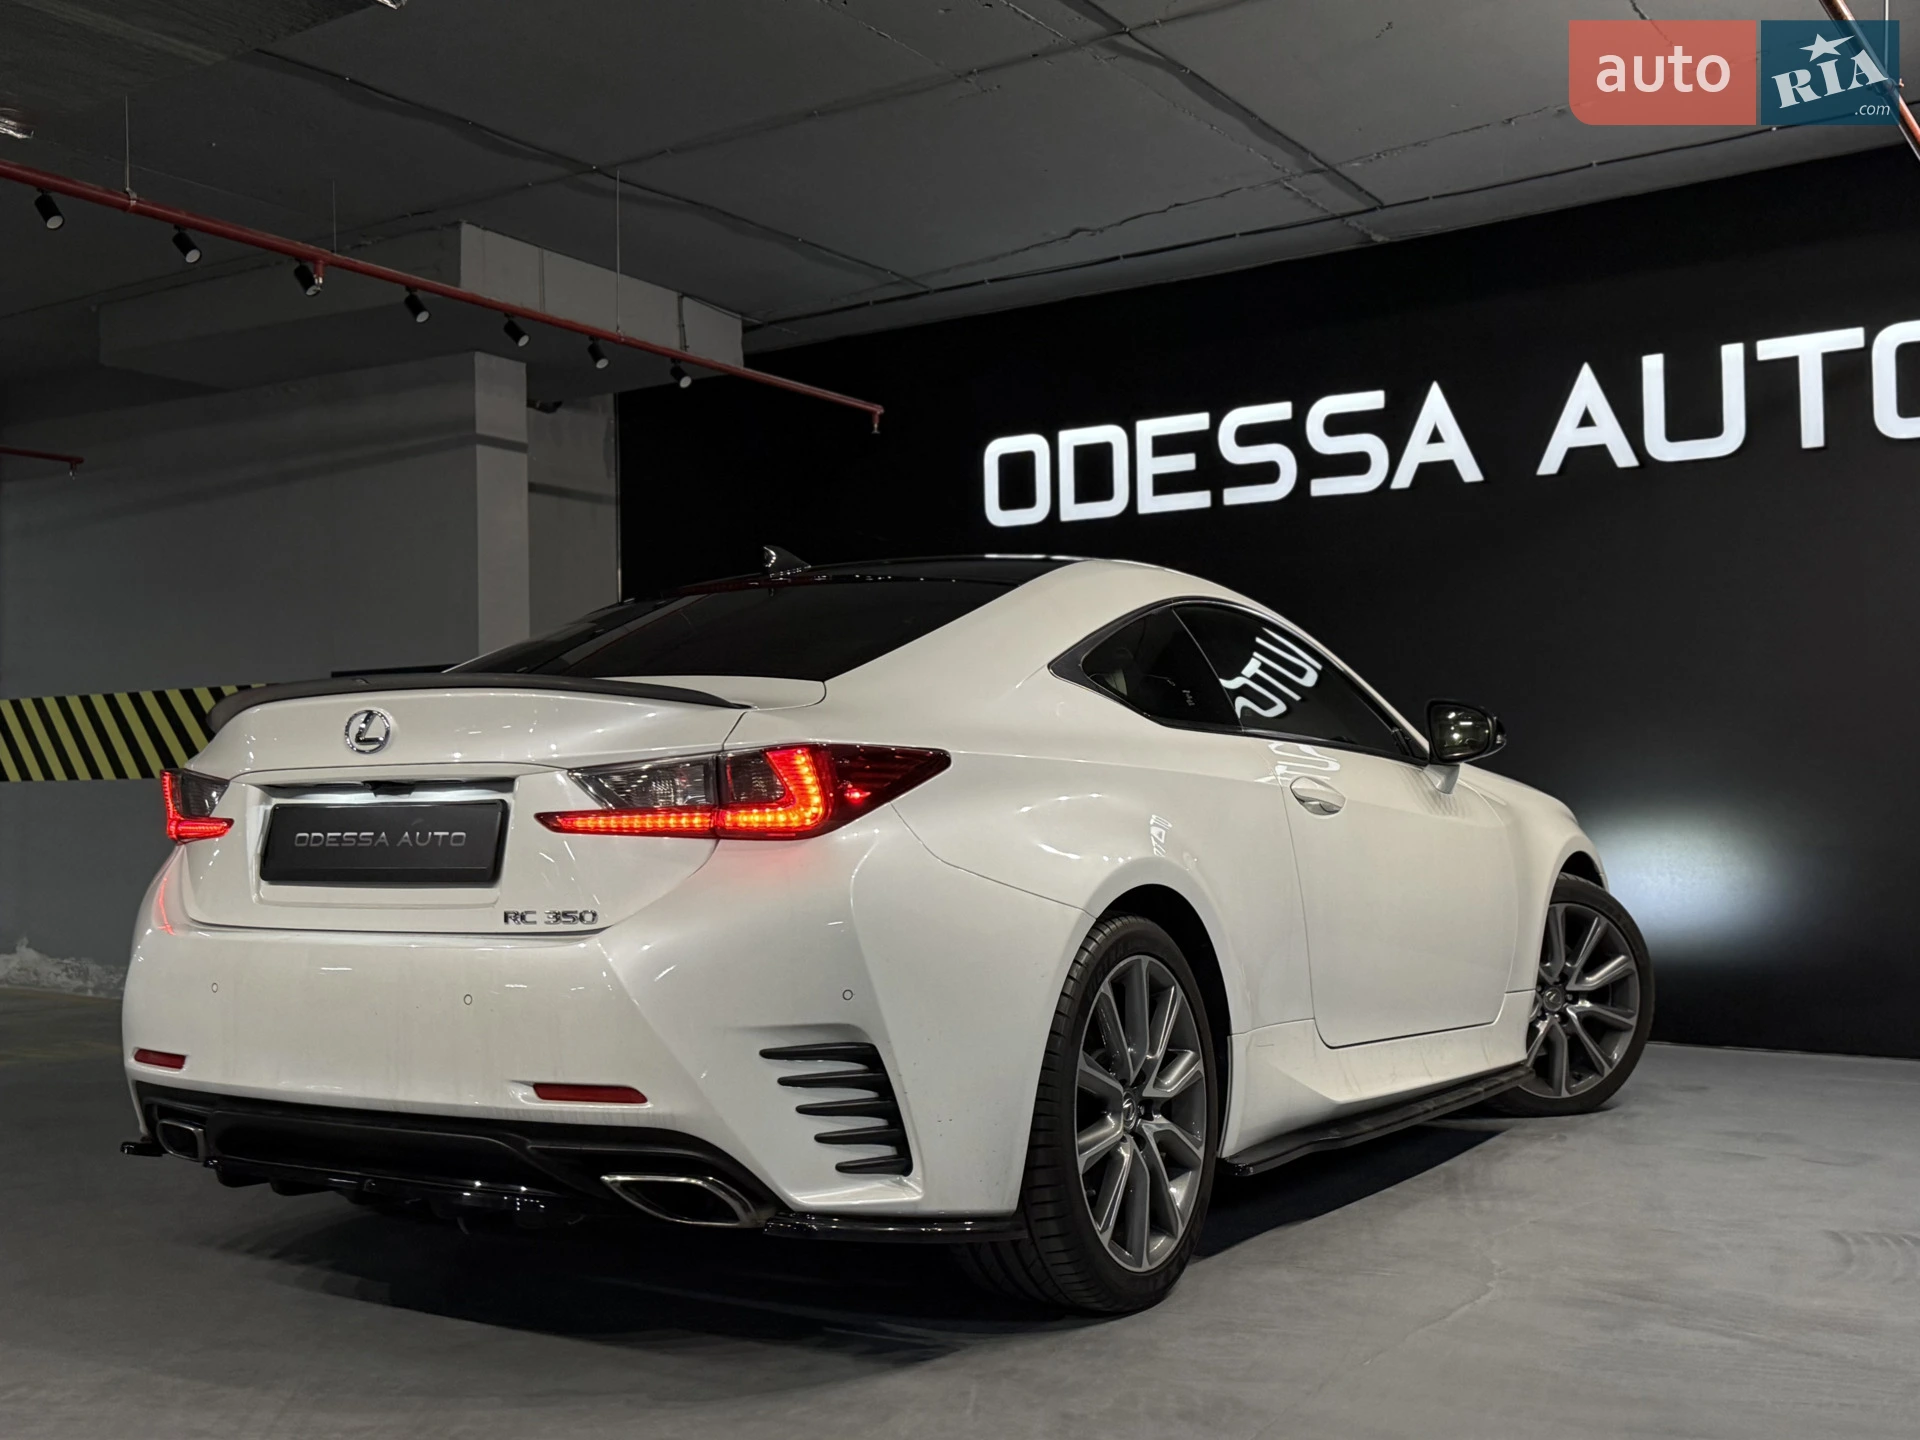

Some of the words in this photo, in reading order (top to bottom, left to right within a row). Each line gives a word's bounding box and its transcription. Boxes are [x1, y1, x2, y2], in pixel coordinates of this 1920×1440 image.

[983, 380, 1484, 528] ODESSA
[294, 831, 389, 848] ODESSA
[396, 830, 467, 847] AUTO
[503, 910, 537, 925] RC
[543, 909, 599, 925] 350
